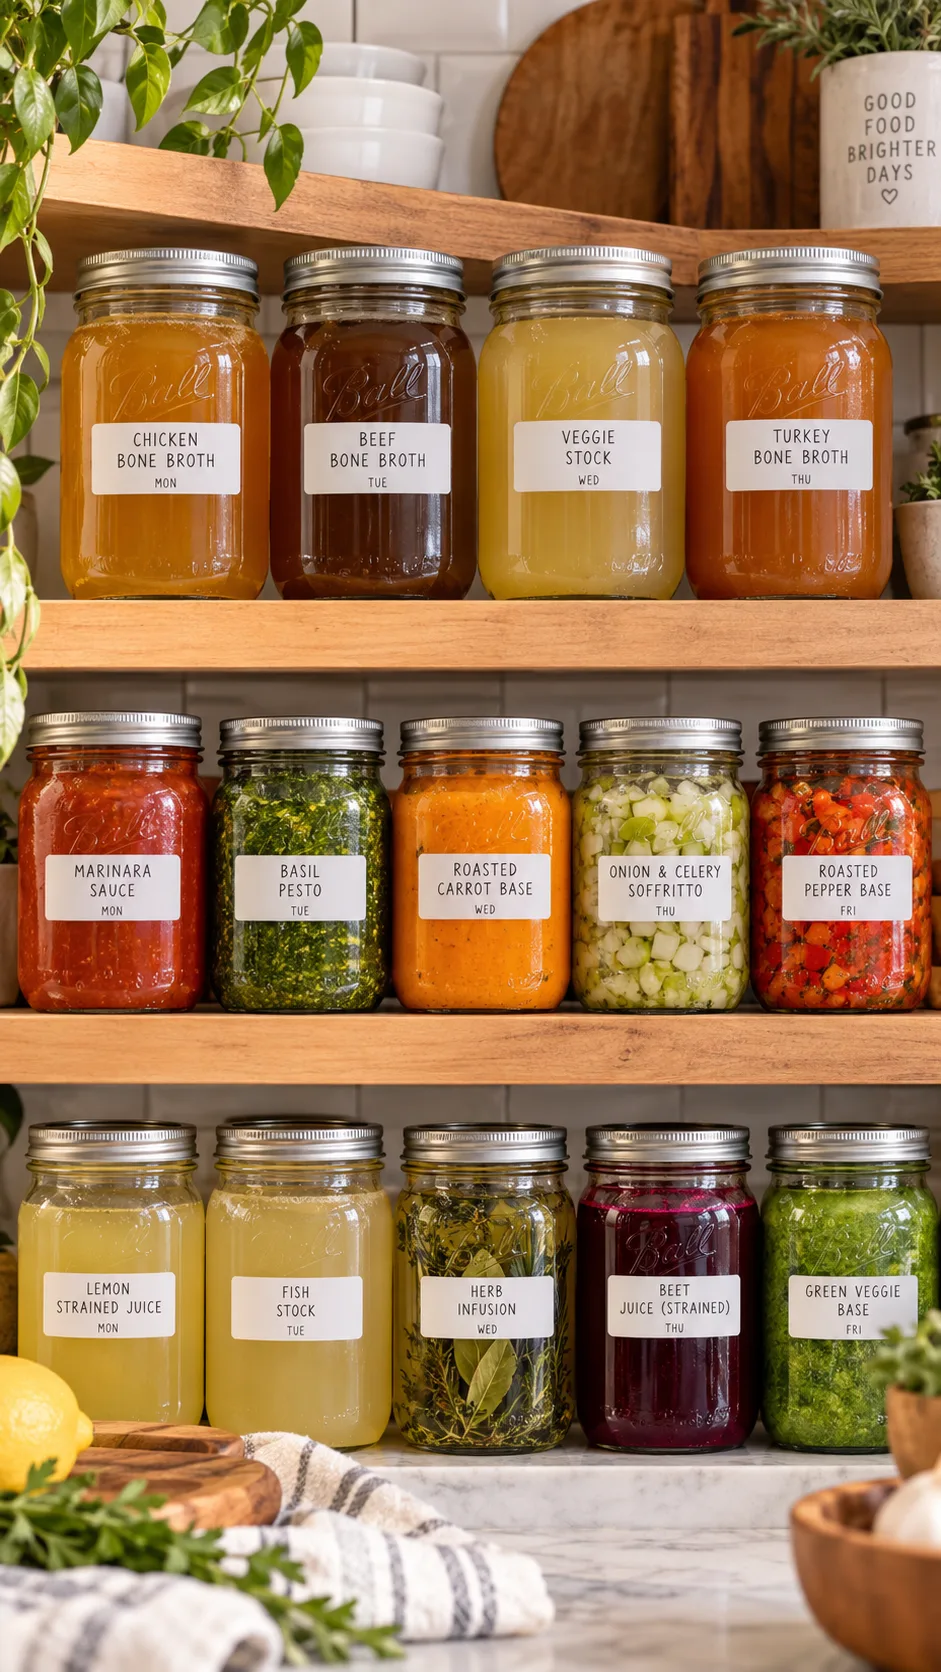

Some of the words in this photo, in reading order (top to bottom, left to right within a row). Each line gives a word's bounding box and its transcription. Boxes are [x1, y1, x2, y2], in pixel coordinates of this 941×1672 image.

[865, 92, 916, 112] GOOD
[864, 116, 915, 136] FOOD
[848, 140, 936, 163] BRIGHTER
[867, 164, 913, 184] DAYS
[110, 362, 215, 421] Ball
[322, 362, 427, 421] Ball
[532, 359, 635, 418] Ball
[744, 360, 846, 418] Ball
[133, 431, 198, 448] CHICKEN
[359, 431, 396, 447] BEEF
[561, 429, 616, 445] VEGGIE
[772, 428, 831, 444] TURKEY
[117, 452, 157, 469] BONE
[166, 452, 215, 469] BROTH
[330, 452, 369, 469] BONE
[378, 452, 426, 469] BROTH
[565, 450, 612, 466] STOCK
[753, 448, 793, 465] BONE
[802, 448, 849, 465] BROTH
[154, 477, 177, 489] MON
[367, 476, 388, 489] TUE
[578, 474, 600, 486] WED
[791, 473, 811, 485] THU
[74, 863, 152, 879] MARINARA
[280, 863, 321, 879] BASIL
[453, 861, 518, 877] ROASTED
[608, 863, 651, 879] ONION
[658, 864, 668, 879] &
[674, 863, 722, 879] CELERY
[819, 863, 878, 879] ROASTED
[89, 882, 135, 898] SAUCE
[279, 882, 322, 898] PESTO
[437, 881, 492, 896] CARROT
[499, 881, 533, 896] BASE
[628, 883, 703, 898] SOFFRITTO
[804, 882, 853, 898] PEPPER
[859, 882, 892, 898] BASE
[101, 905, 123, 916] MON
[290, 905, 310, 917] TUE
[474, 903, 496, 915] WED
[655, 905, 676, 917] THU
[840, 905, 856, 916] FRI
[626, 1222, 717, 1275] Ball
[86, 1281, 130, 1296] LEMON
[282, 1285, 310, 1300] FISH
[470, 1284, 503, 1299] HERB
[659, 1283, 691, 1297] BEET
[805, 1284, 848, 1299] GREEN
[854, 1284, 901, 1299] VEGGIE
[56, 1299, 119, 1315] STRAINED
[126, 1299, 162, 1315] JUICE
[276, 1303, 316, 1318] STOCK
[457, 1302, 517, 1316] INFUSION
[619, 1301, 654, 1316] JUICE
[660, 1300, 731, 1317] (STRAINED)
[837, 1302, 870, 1317] BASE
[97, 1322, 119, 1334] MON
[286, 1324, 305, 1336] TUE
[477, 1323, 498, 1335] WED
[665, 1322, 685, 1334] THU
[846, 1323, 862, 1335] FRI
